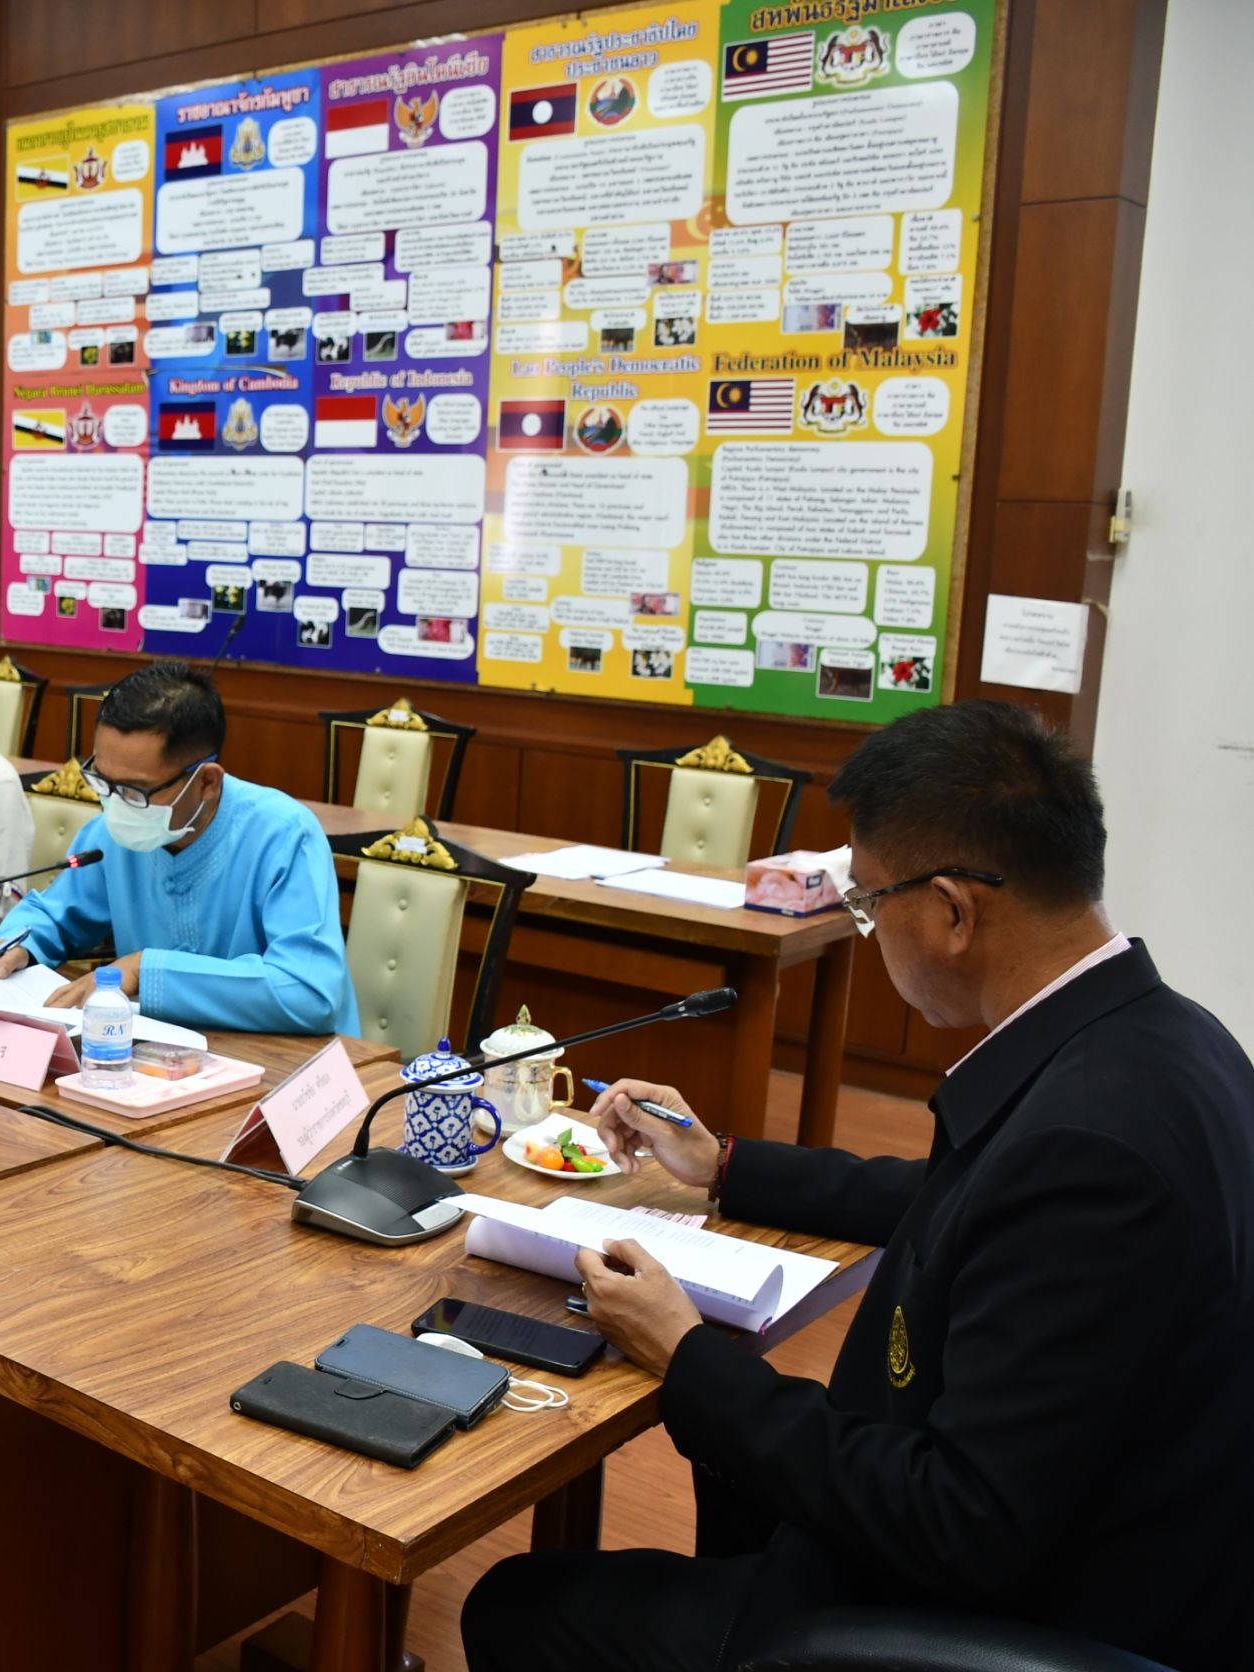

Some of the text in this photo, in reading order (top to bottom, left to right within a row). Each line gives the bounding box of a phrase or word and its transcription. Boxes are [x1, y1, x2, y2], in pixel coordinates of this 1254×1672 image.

[566, 51, 659, 79] ประชาชนลาว
[544, 358, 605, 378] People's
[610, 354, 700, 373] Democratic
[712, 347, 956, 374] Federation of Malaysia
[169, 376, 299, 397] Kingdom of Cambodia
[330, 368, 474, 393] Republic of Indonesia
[570, 381, 638, 402] Republic
